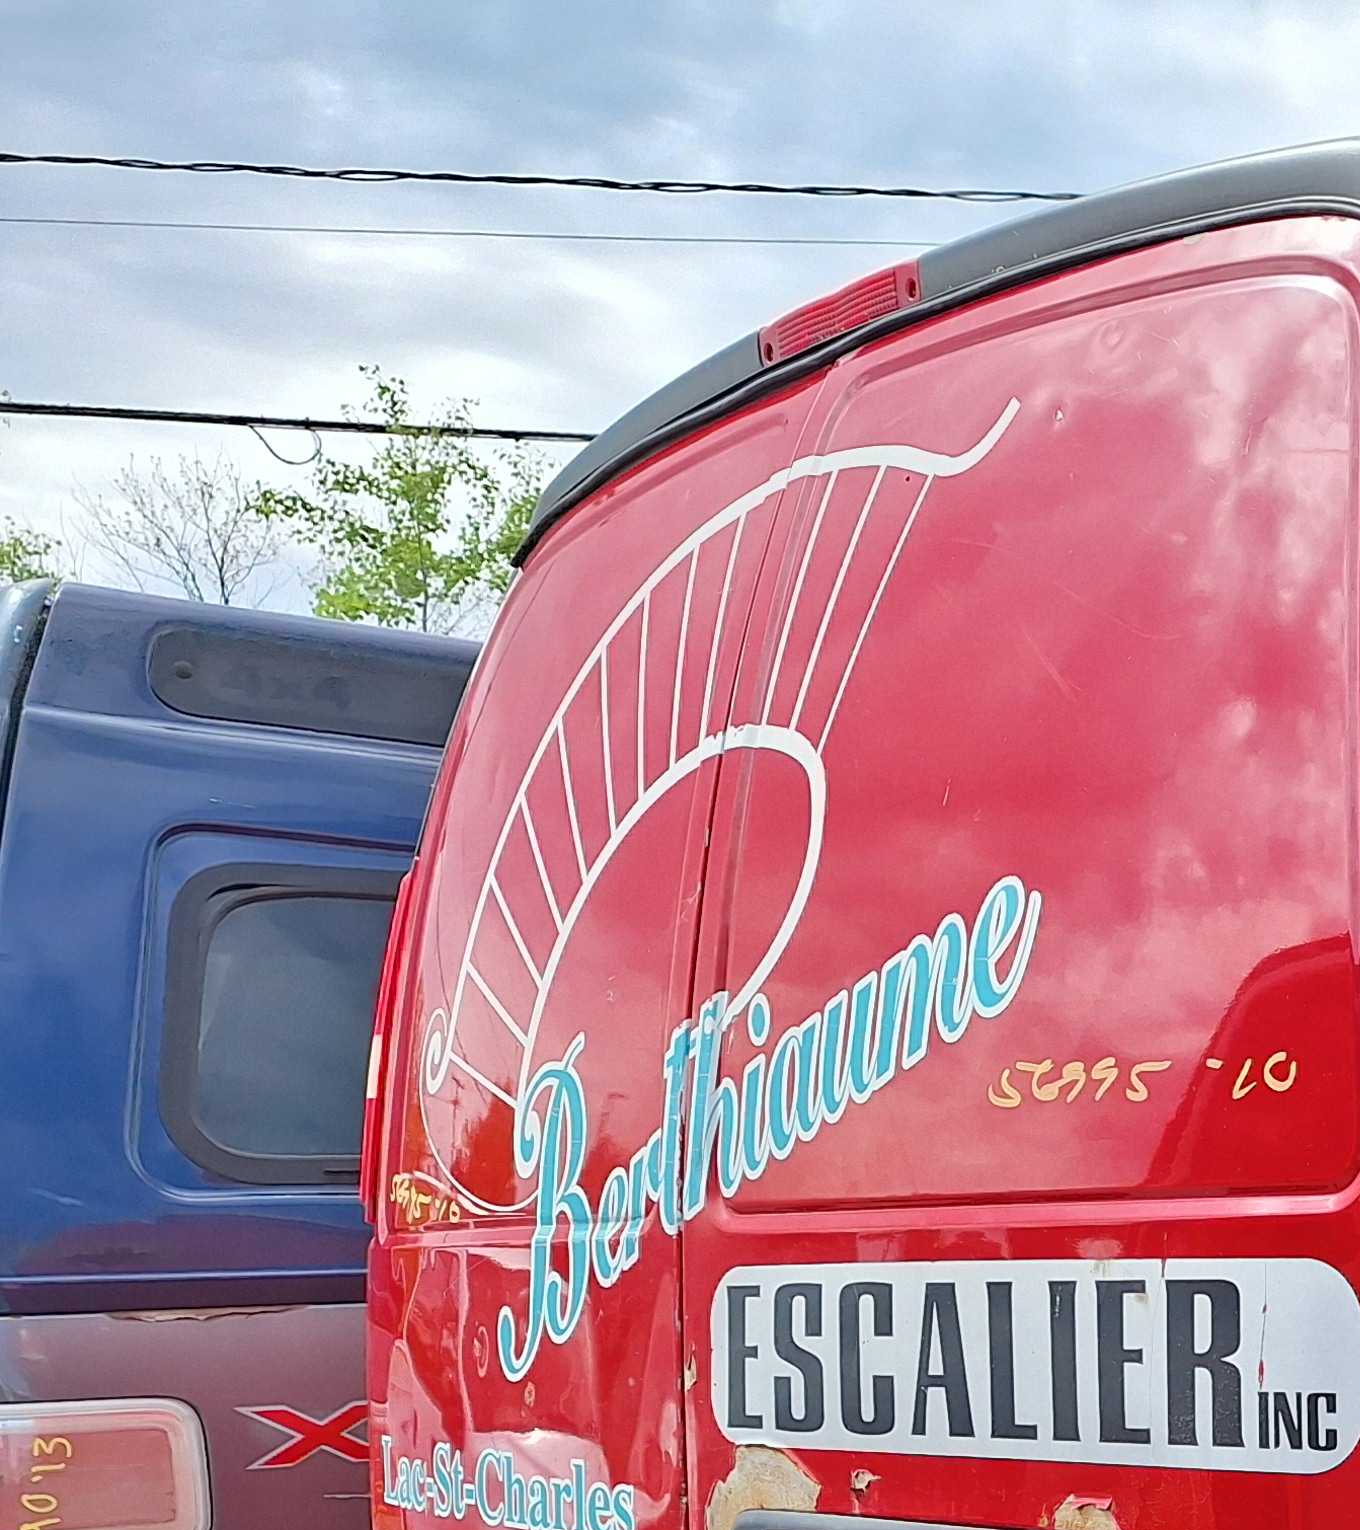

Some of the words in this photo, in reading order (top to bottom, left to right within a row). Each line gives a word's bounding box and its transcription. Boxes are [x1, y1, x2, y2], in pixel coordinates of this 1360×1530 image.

[498, 875, 1042, 1382] Berthiaume
[988, 1056, 1172, 1108] 56995
[727, 1279, 1245, 1448] ESCALIER
[1258, 1390, 1338, 1452] INC
